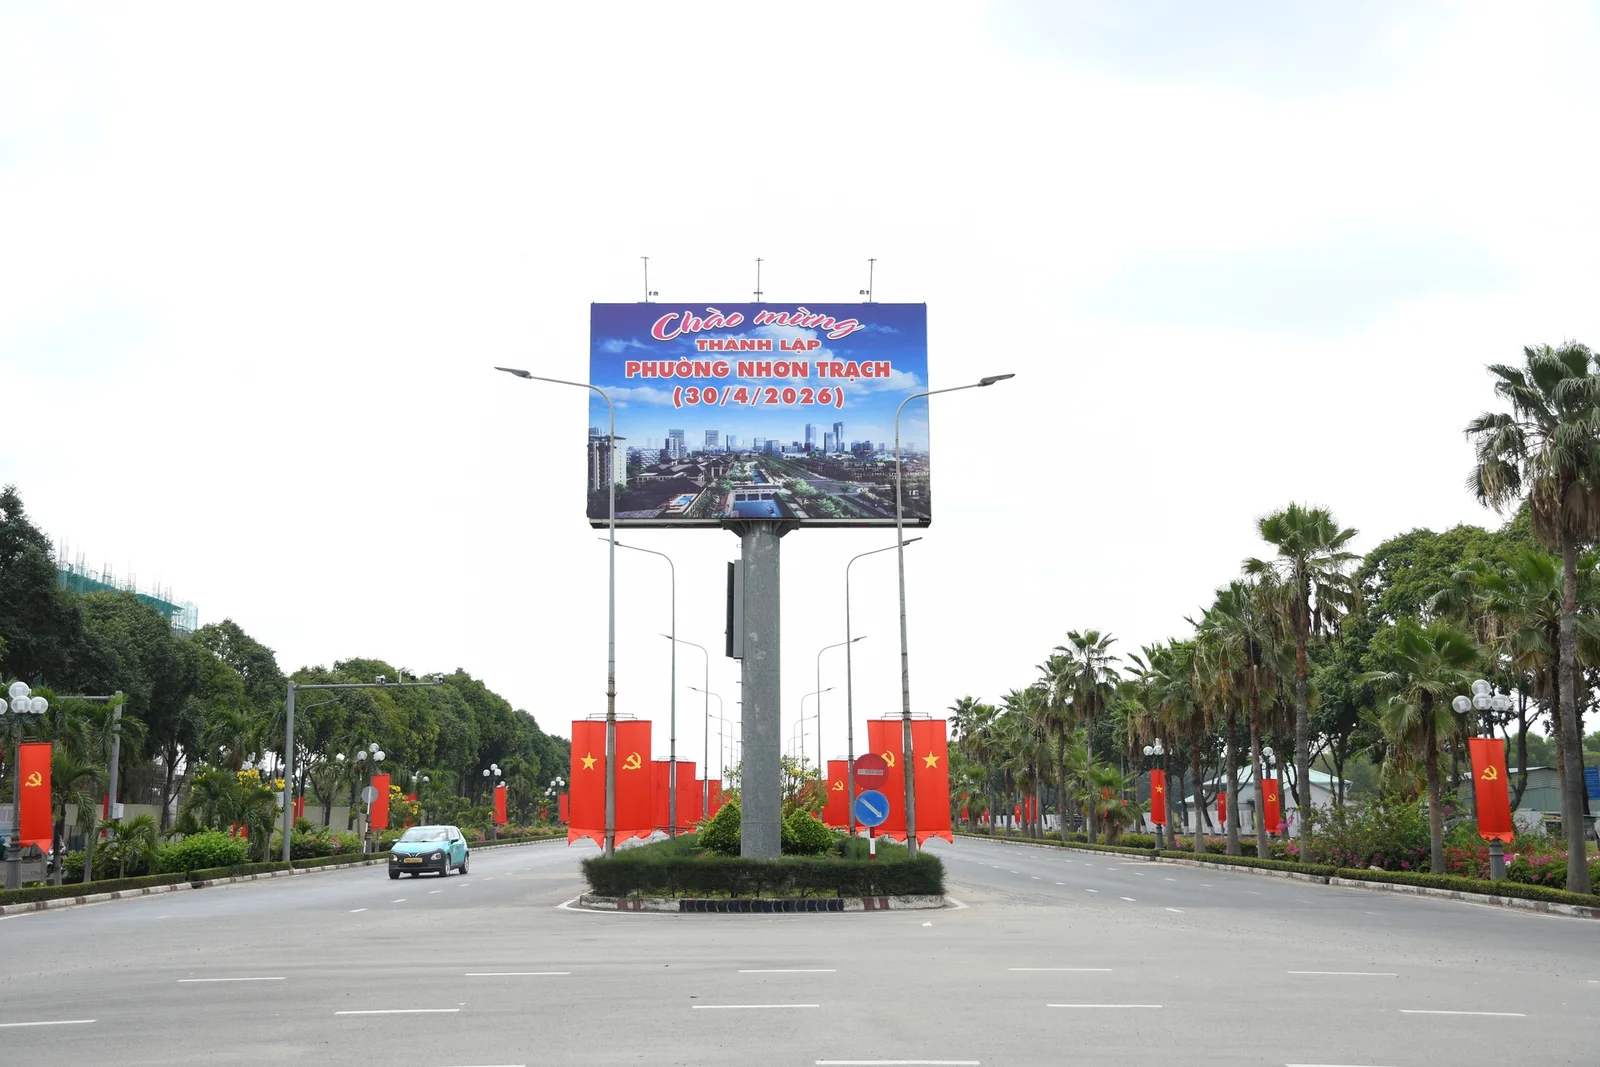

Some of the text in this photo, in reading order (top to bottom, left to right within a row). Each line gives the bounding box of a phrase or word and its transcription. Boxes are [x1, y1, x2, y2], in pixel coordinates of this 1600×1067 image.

[651, 307, 865, 341] Chào mừng
[695, 337, 821, 354] THÀNH LẬP
[625, 357, 892, 382] PHƯỜNG NHƠN TRẠCH
[673, 386, 845, 409] (30/4/2026)
